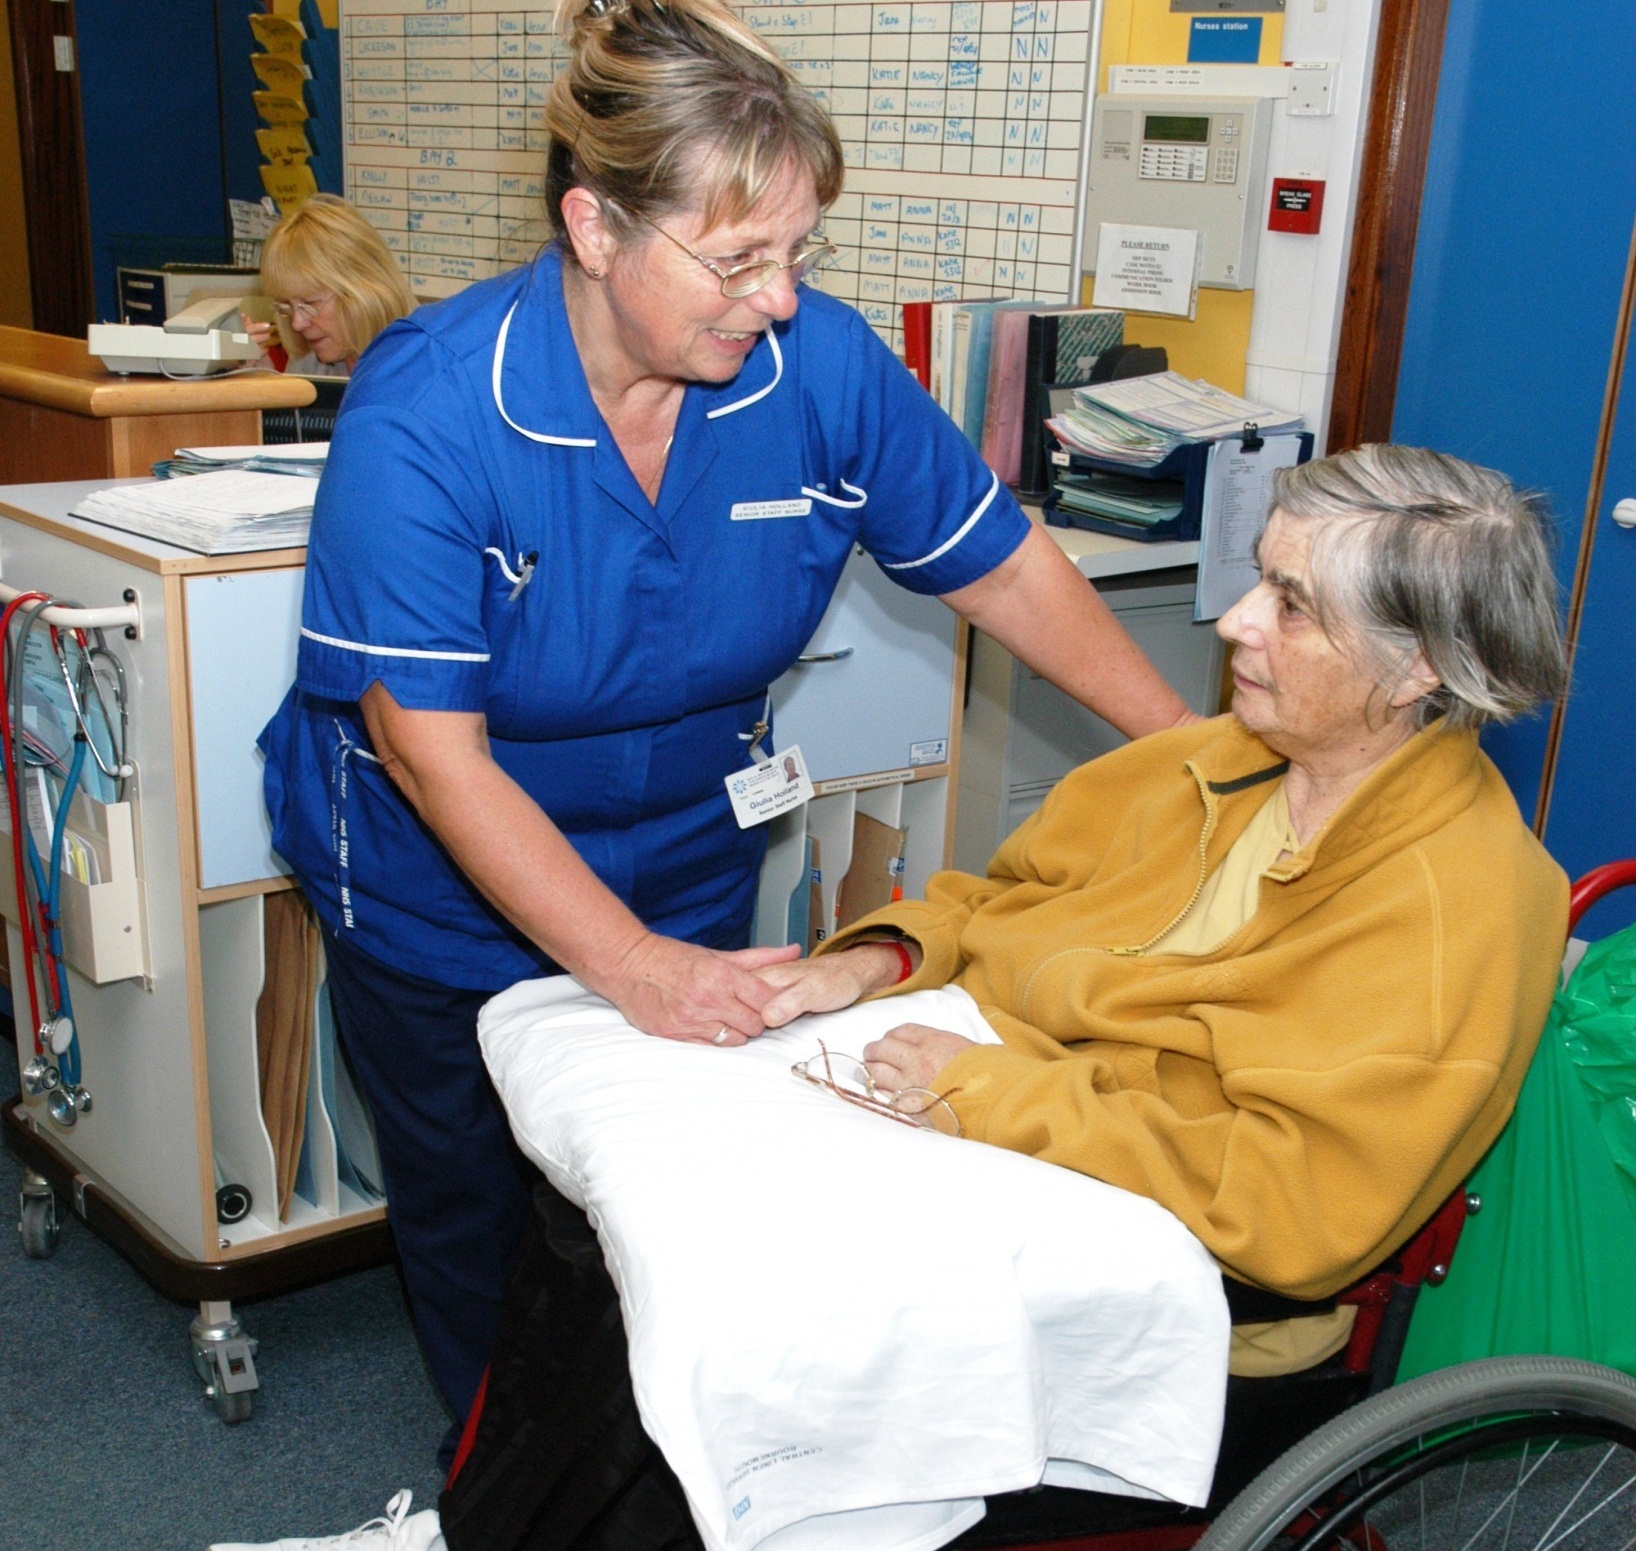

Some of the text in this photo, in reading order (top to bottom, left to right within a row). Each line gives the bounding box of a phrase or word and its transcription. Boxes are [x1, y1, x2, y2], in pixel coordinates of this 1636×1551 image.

[1195, 22, 1248, 31] Nurses station
[1017, 37, 1048, 58] N N
[1012, 70, 1043, 85] N N
[1009, 124, 1044, 144] N N
[1005, 211, 1034, 226] N N
[1121, 240, 1170, 251] PLEASE RETURN
[998, 266, 1008, 279] N
[749, 797, 773, 810] Giulia
[774, 782, 800, 800] Holland
[340, 839, 349, 868] STAFF
[341, 886, 352, 906] NHS
[781, 1446, 823, 1462] CENTRAL
[752, 1457, 778, 1472] LINEN
